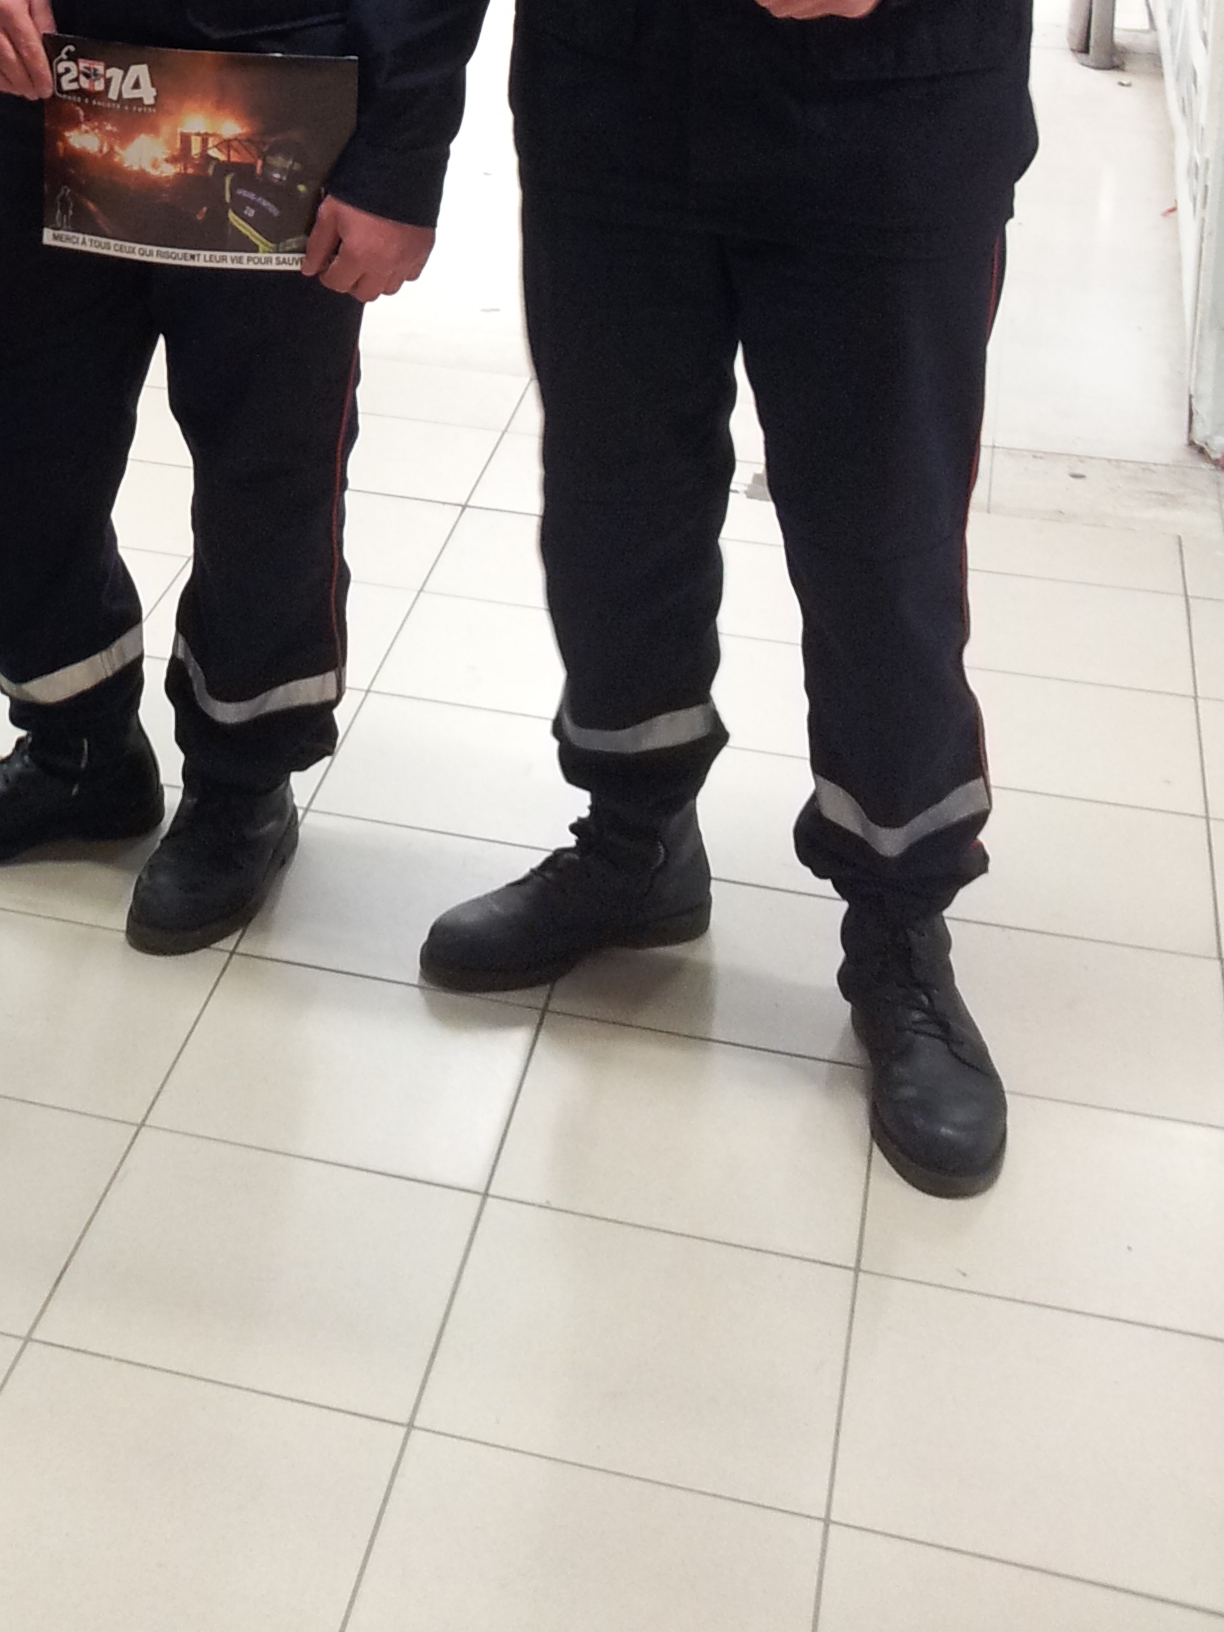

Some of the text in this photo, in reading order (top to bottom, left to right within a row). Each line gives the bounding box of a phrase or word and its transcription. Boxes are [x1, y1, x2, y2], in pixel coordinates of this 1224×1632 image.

[52, 232, 80, 246] MERCI
[88, 238, 112, 250] TOUS
[113, 243, 136, 255] CEUX
[138, 247, 154, 258] QUI
[156, 248, 200, 263] RISQUENT
[204, 254, 228, 263] LEUR
[230, 255, 244, 264] VIE
[247, 255, 273, 265] POUR
